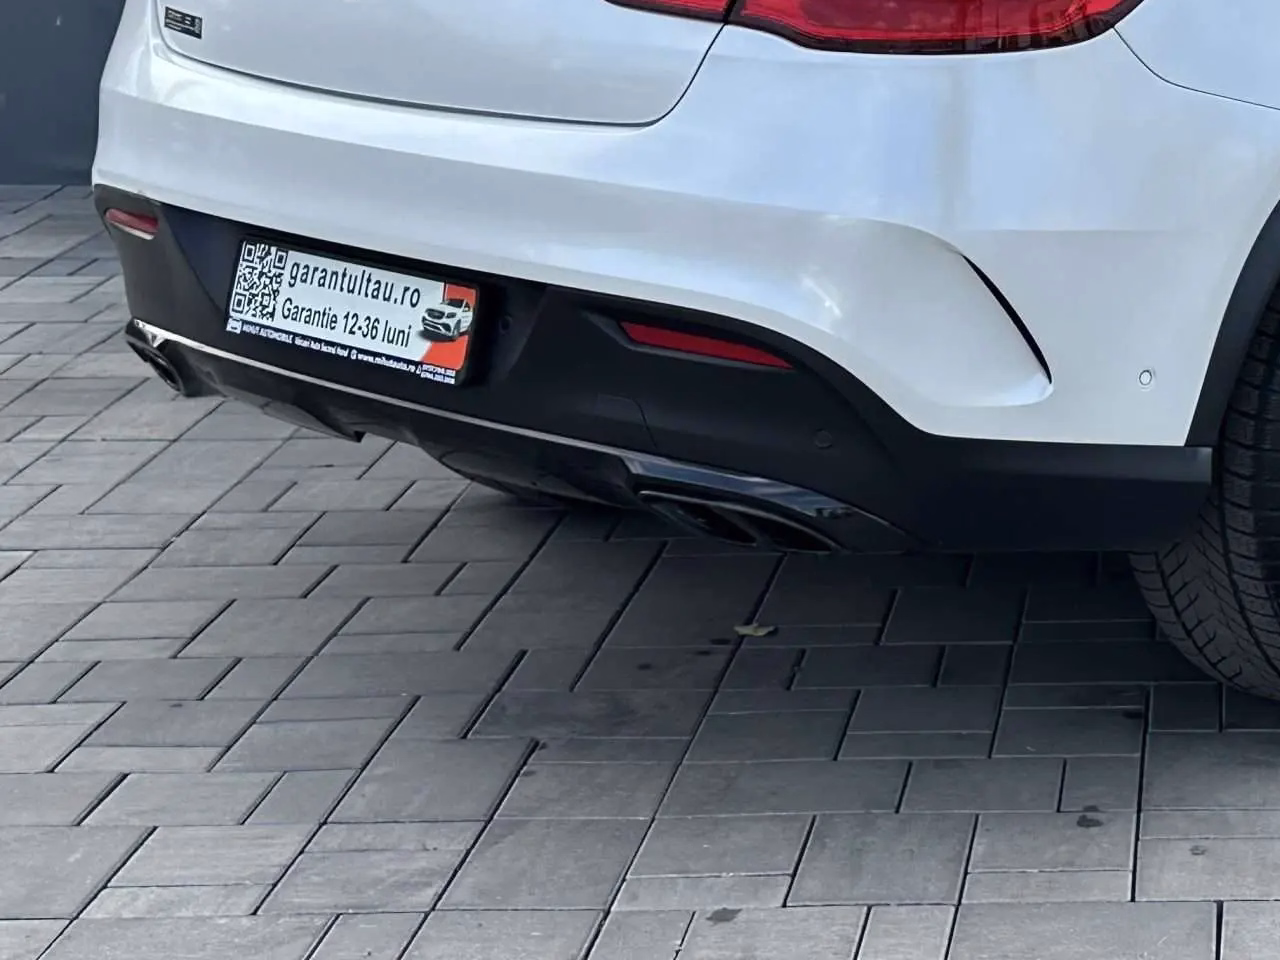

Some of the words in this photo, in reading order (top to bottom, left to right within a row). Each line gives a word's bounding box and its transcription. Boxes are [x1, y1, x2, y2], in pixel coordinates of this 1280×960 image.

[287, 261, 422, 309] garantultau.ro
[281, 297, 338, 331] Garantie
[342, 310, 381, 341] 12-36
[382, 319, 413, 349] luni
